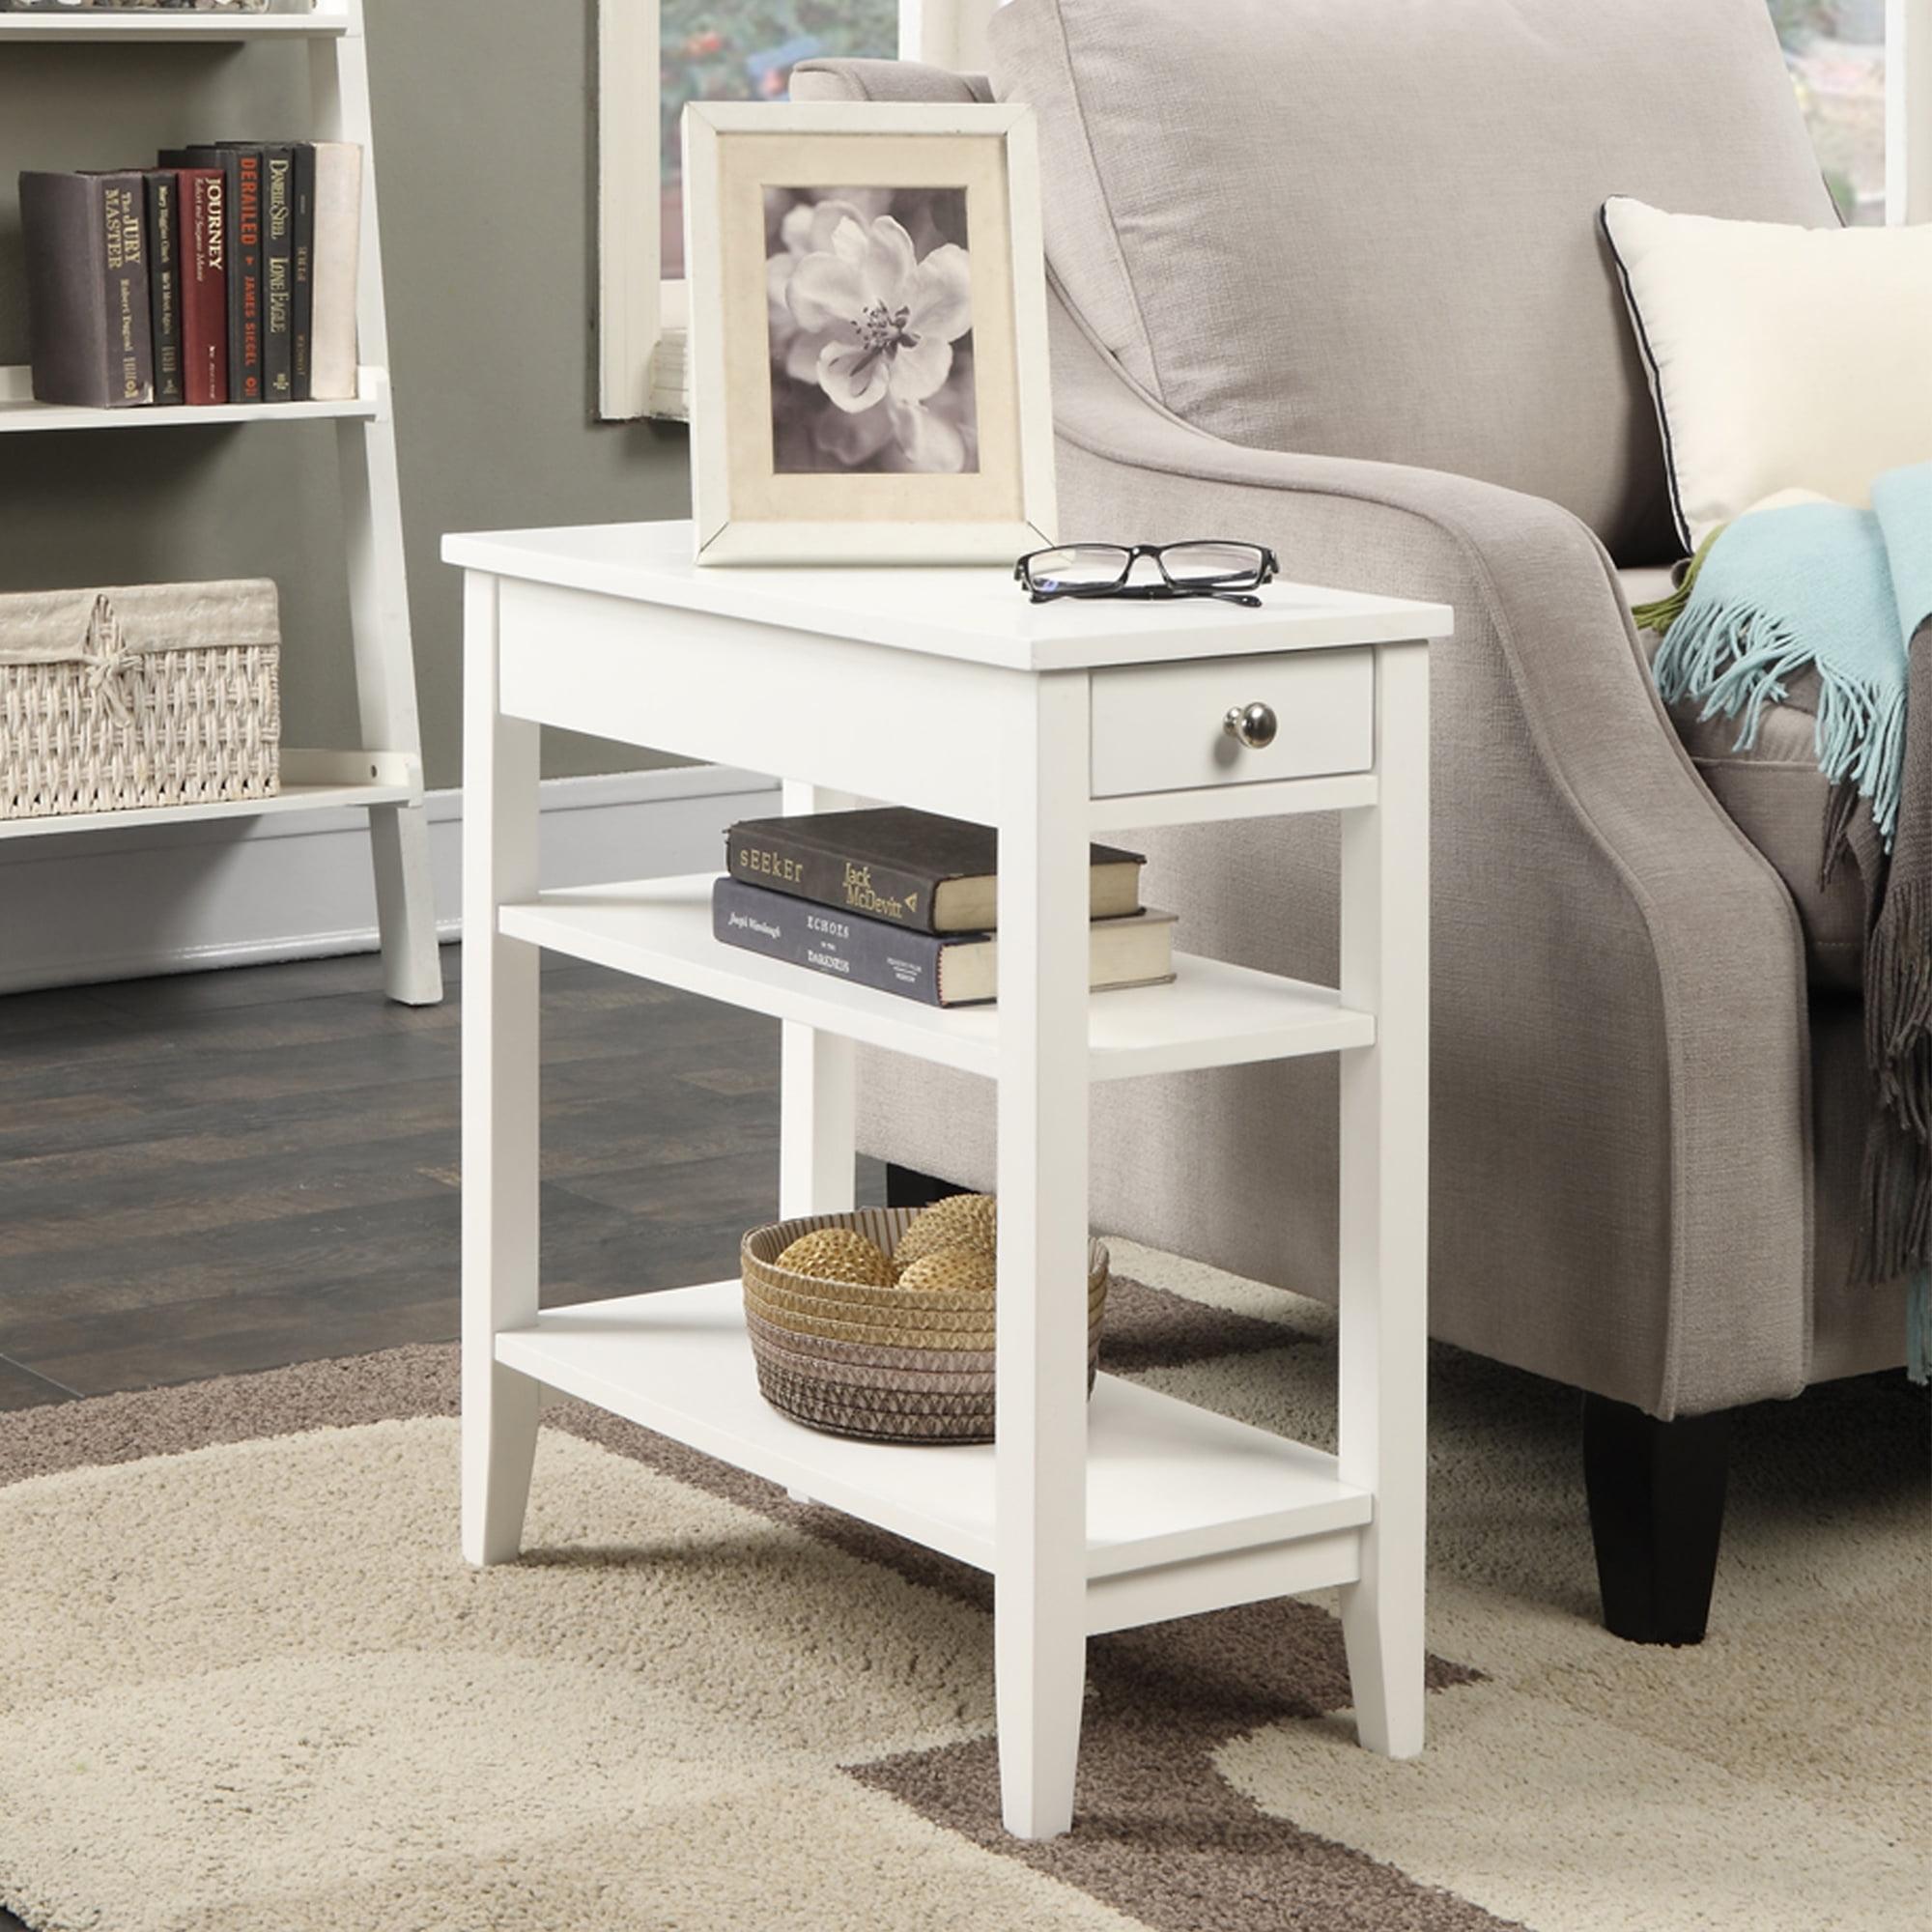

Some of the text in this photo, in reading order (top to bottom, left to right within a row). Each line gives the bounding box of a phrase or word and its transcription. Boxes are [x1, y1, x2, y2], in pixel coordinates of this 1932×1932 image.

[205, 178, 223, 270] JOURNEY
[241, 157, 258, 245] DERAILED
[105, 188, 123, 270] MASTER
[123, 214, 141, 265] JURY
[244, 276, 256, 318] JAMES
[270, 257, 290, 332] LONE EAGLE
[244, 323, 257, 367] SIEGEL
[842, 862, 872, 888] Jack
[844, 886, 903, 920] McDevitt
